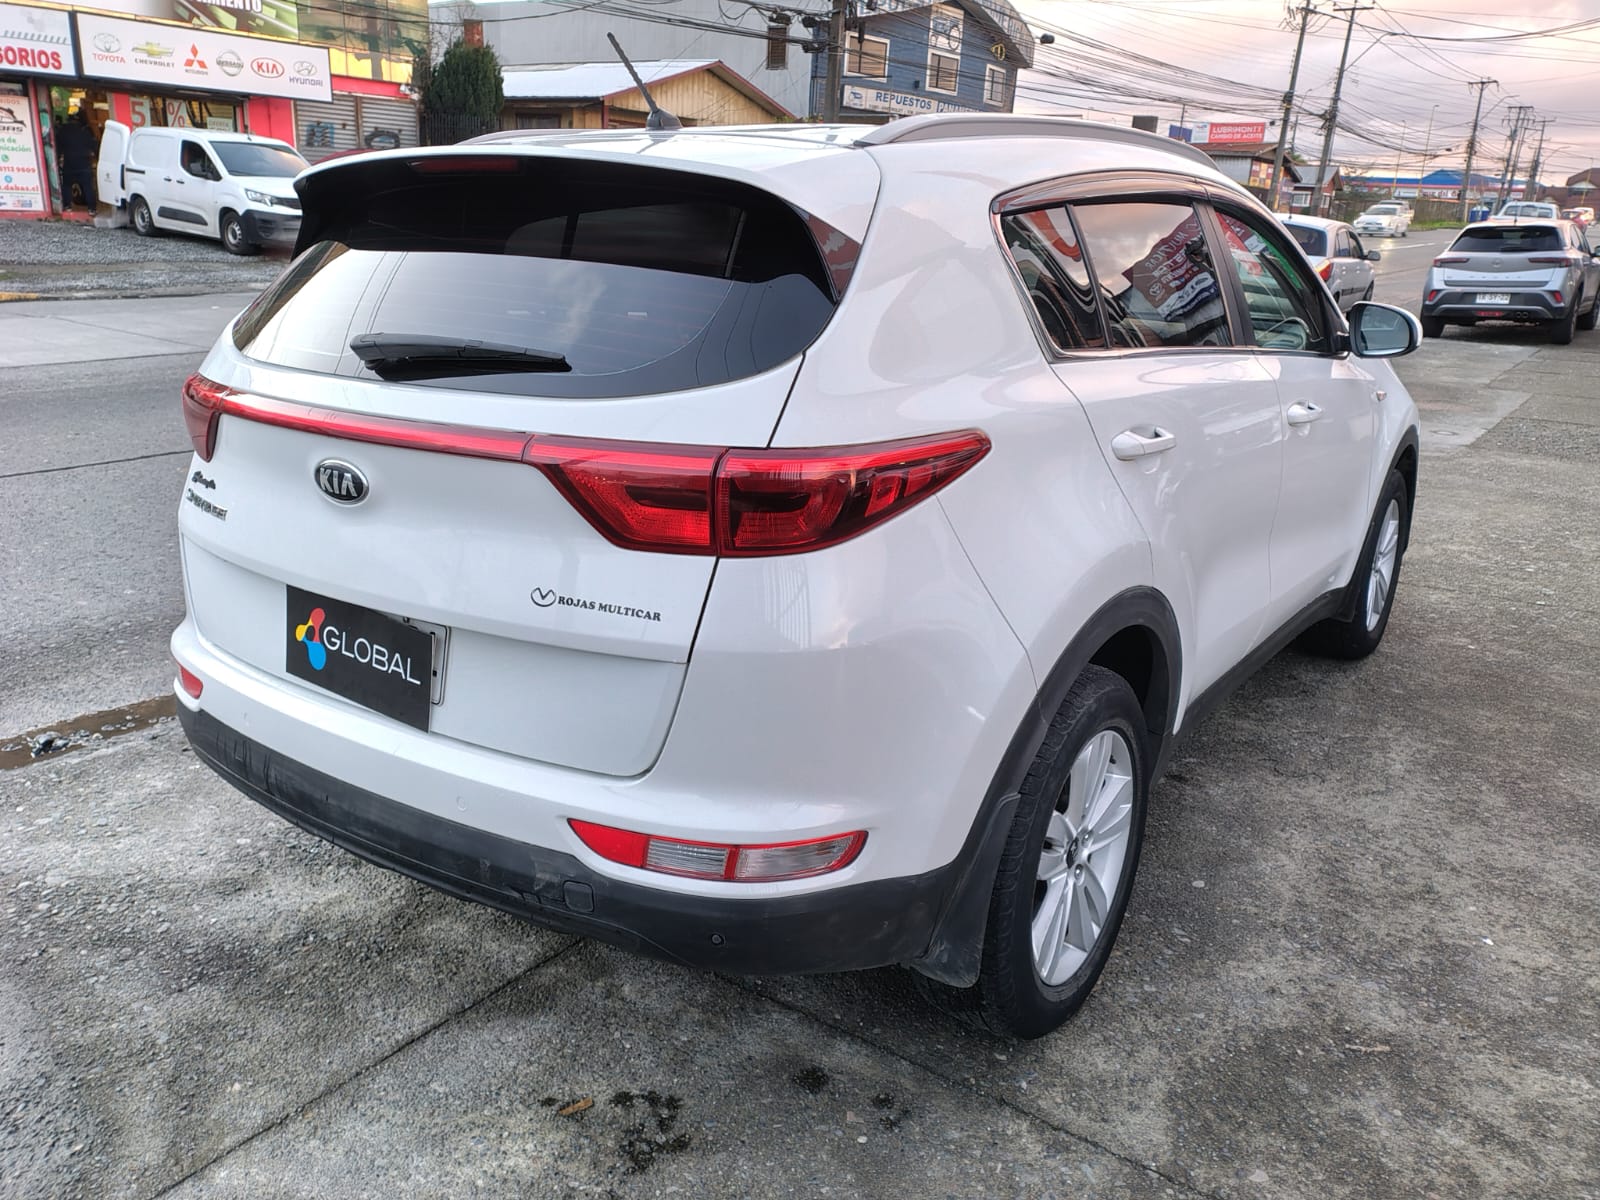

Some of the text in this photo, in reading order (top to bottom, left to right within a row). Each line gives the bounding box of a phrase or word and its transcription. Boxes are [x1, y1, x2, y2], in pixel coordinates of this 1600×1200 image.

[92, 53, 126, 64] TOYOTA
[134, 58, 175, 68] CHEVROLET
[256, 61, 280, 75] KIA
[289, 76, 323, 87] HYUNDAI
[875, 91, 933, 111] REPUESTOS
[319, 467, 358, 498] KIA
[557, 596, 662, 621] ROJAS MULTICAR
[323, 626, 421, 685] GLOBAL
